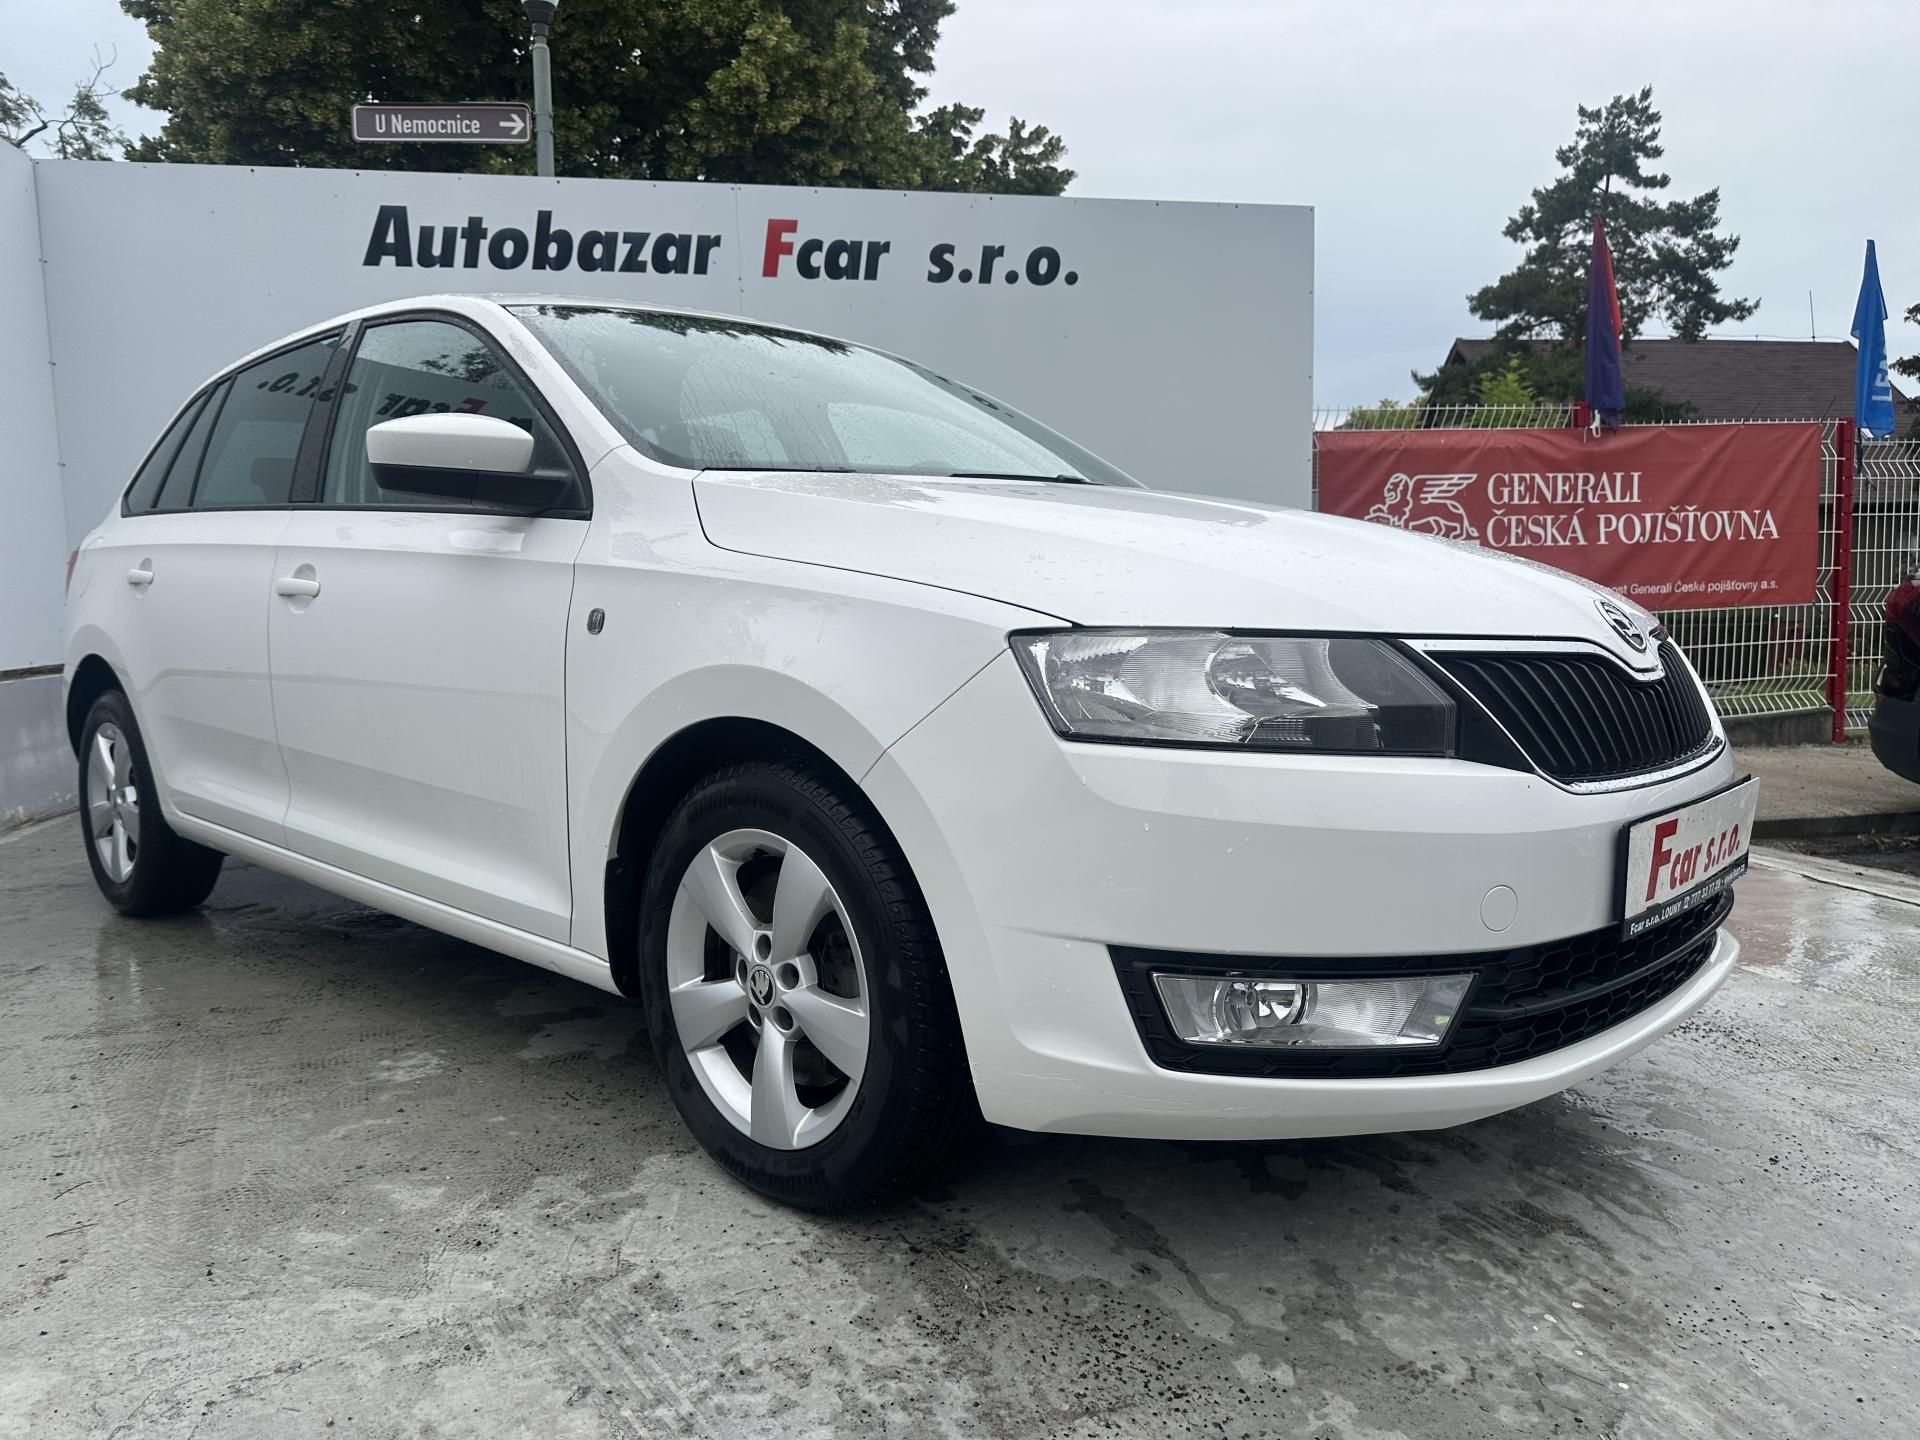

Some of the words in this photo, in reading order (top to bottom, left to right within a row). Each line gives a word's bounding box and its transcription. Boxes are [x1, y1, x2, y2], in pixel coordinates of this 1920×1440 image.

[376, 115, 388, 133] U
[391, 116, 481, 135] Nemocnice
[362, 205, 721, 274] Autobazar
[761, 218, 891, 283] Fcar
[927, 241, 1080, 286] s.r.o.
[1487, 471, 1643, 505] GENERALI
[1487, 508, 1588, 548] ČESKÁ
[1597, 505, 1780, 546] POJIŠŤOVNA
[1630, 582, 1672, 595] Generali
[1674, 579, 1706, 593] České
[1707, 581, 1759, 594] pojišťovny
[1760, 579, 1779, 590] a.s.
[1645, 818, 1702, 902] Fcar
[1703, 823, 1740, 873] s.r.o.
[1630, 920, 1644, 935] Fcar
[1645, 914, 1660, 928] s.r.o.
[1661, 901, 1682, 920] LOUNY
